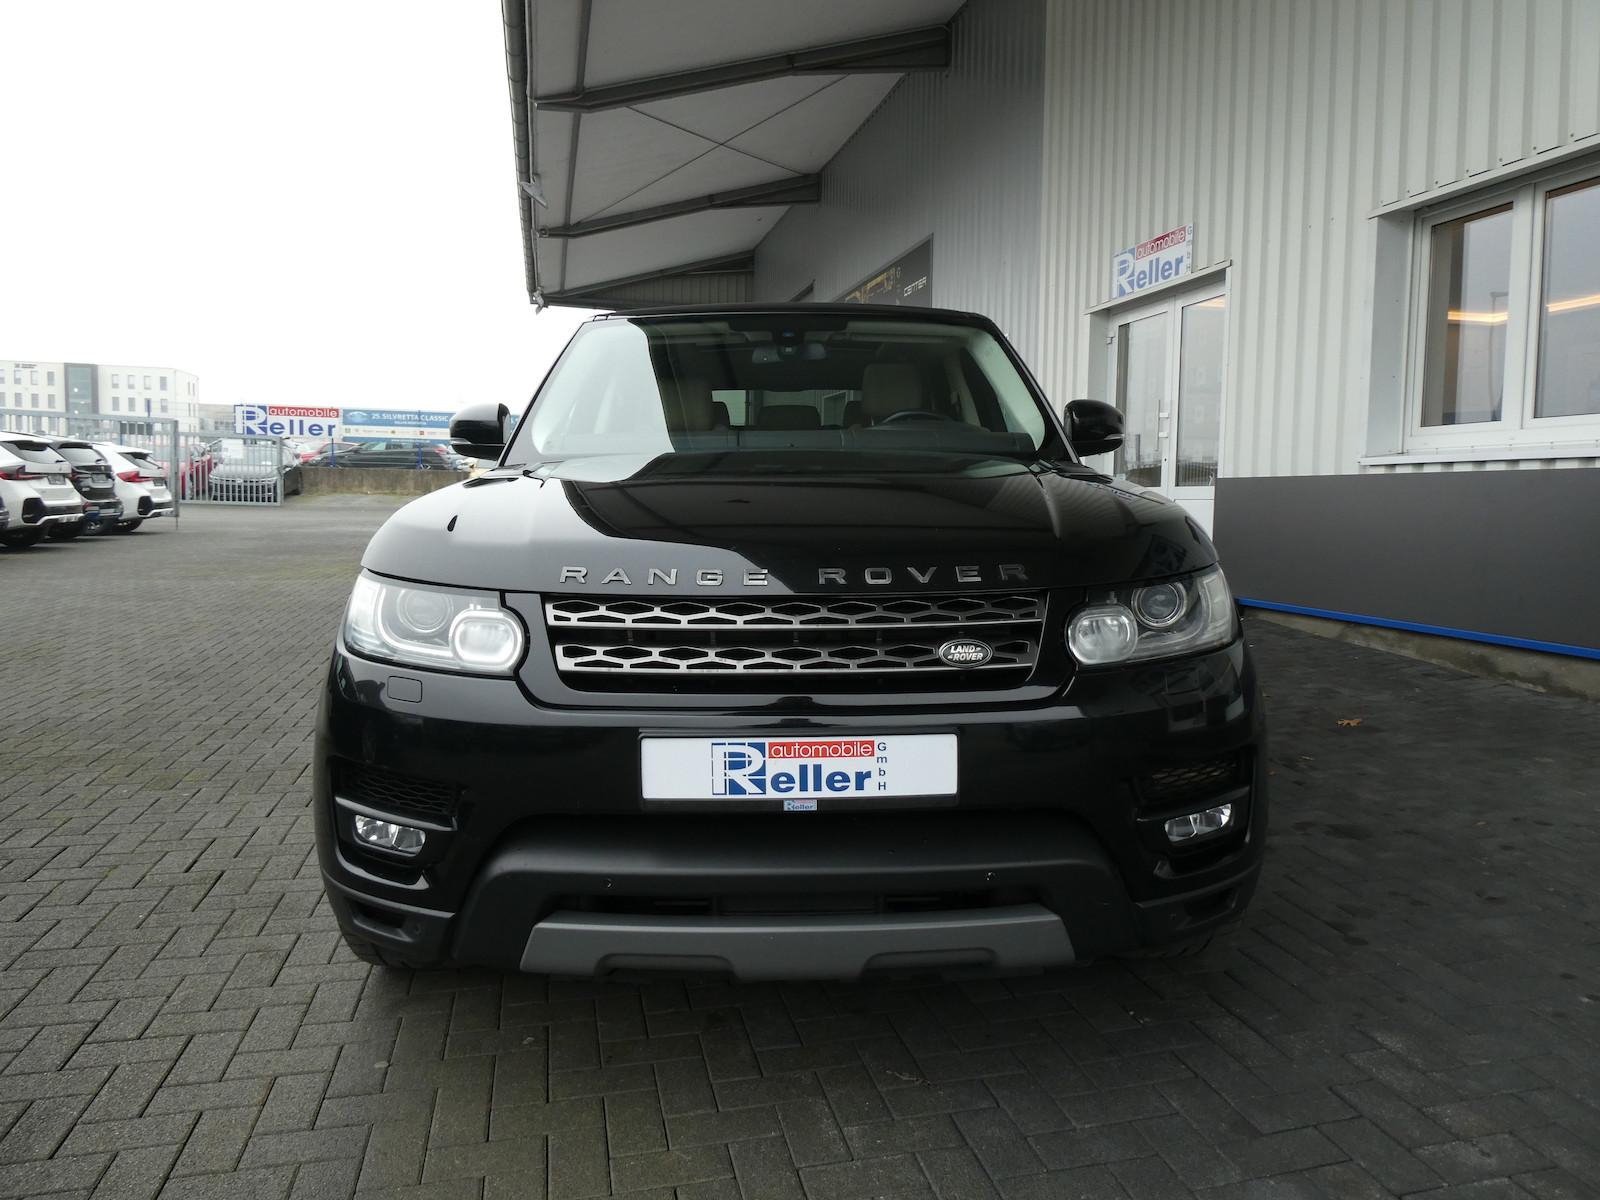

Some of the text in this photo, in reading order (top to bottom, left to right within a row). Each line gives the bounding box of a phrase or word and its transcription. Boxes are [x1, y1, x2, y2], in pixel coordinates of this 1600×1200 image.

[1136, 229, 1185, 259] automobile
[1111, 247, 1184, 299] Reller
[234, 404, 336, 437] Reller
[269, 407, 338, 418] automobile
[420, 414, 449, 422] CLASSIC
[559, 563, 1029, 587] RANGE ROVER
[950, 645, 976, 654] LAND
[952, 652, 984, 661] ROVER
[770, 742, 873, 757] automobile
[711, 742, 872, 796] Reller
